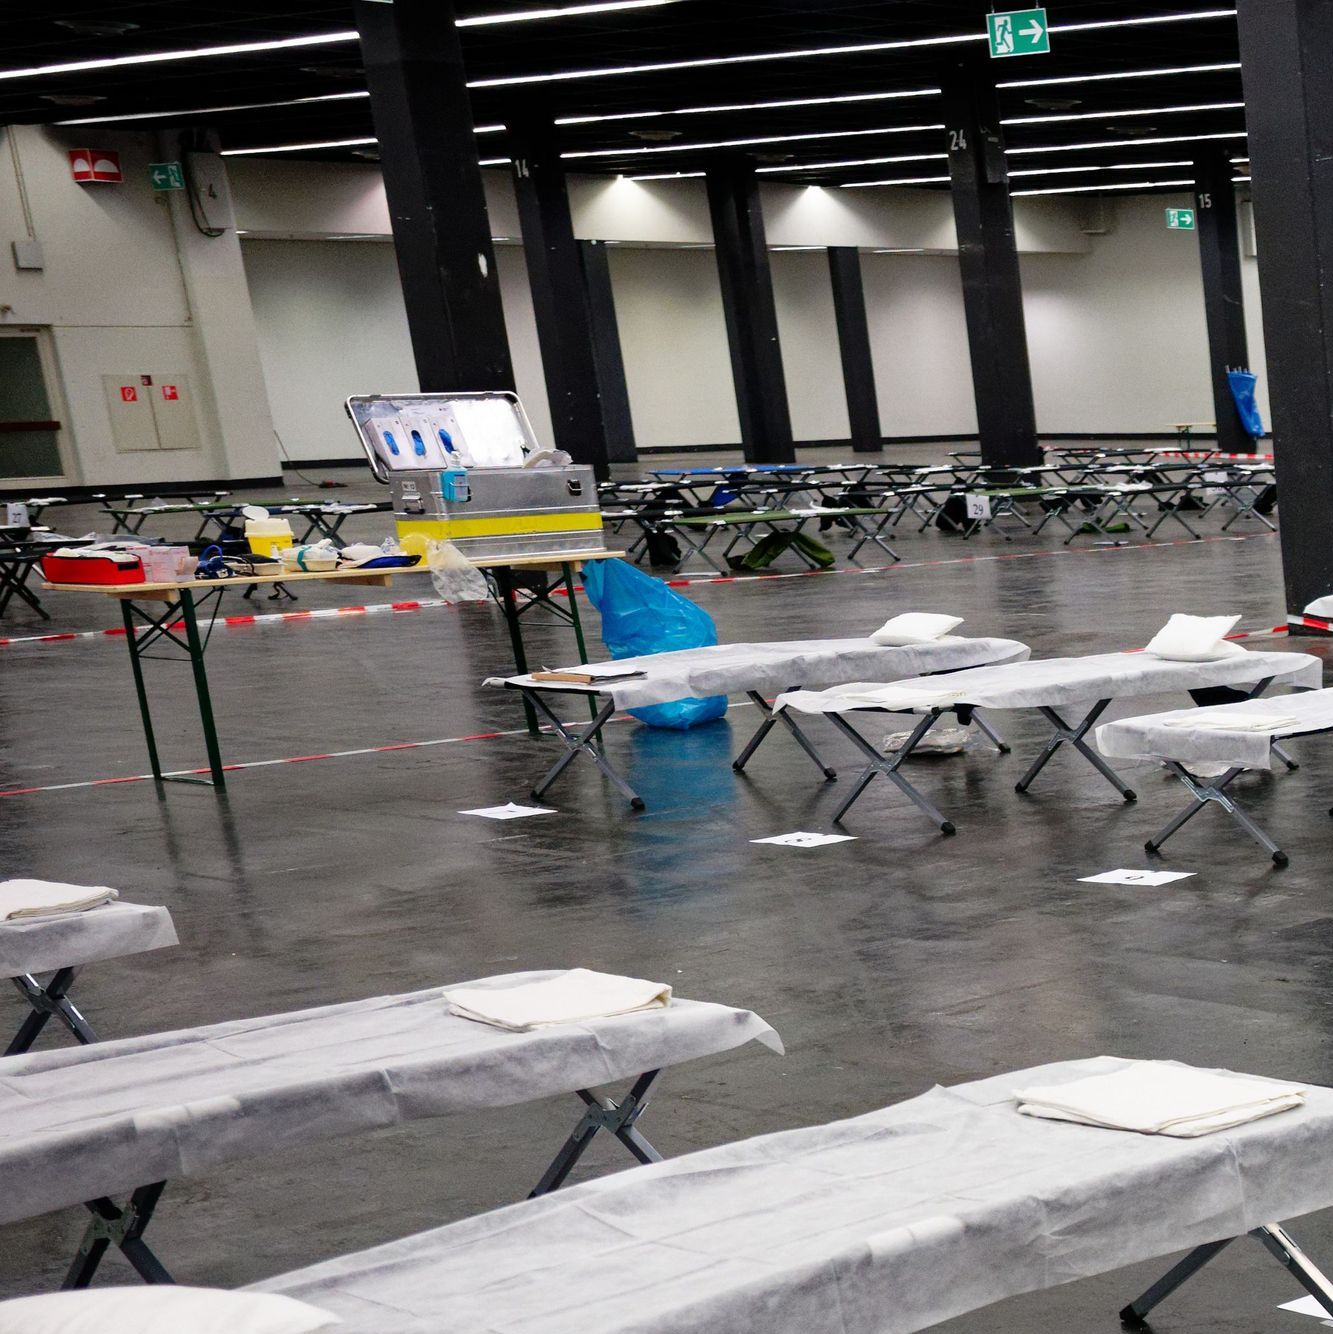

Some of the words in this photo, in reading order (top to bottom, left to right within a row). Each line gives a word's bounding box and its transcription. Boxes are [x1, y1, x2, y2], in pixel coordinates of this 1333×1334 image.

[949, 129, 967, 150] 24
[515, 160, 529, 178] 14
[1199, 193, 1212, 208] 15
[973, 503, 984, 516] 29
